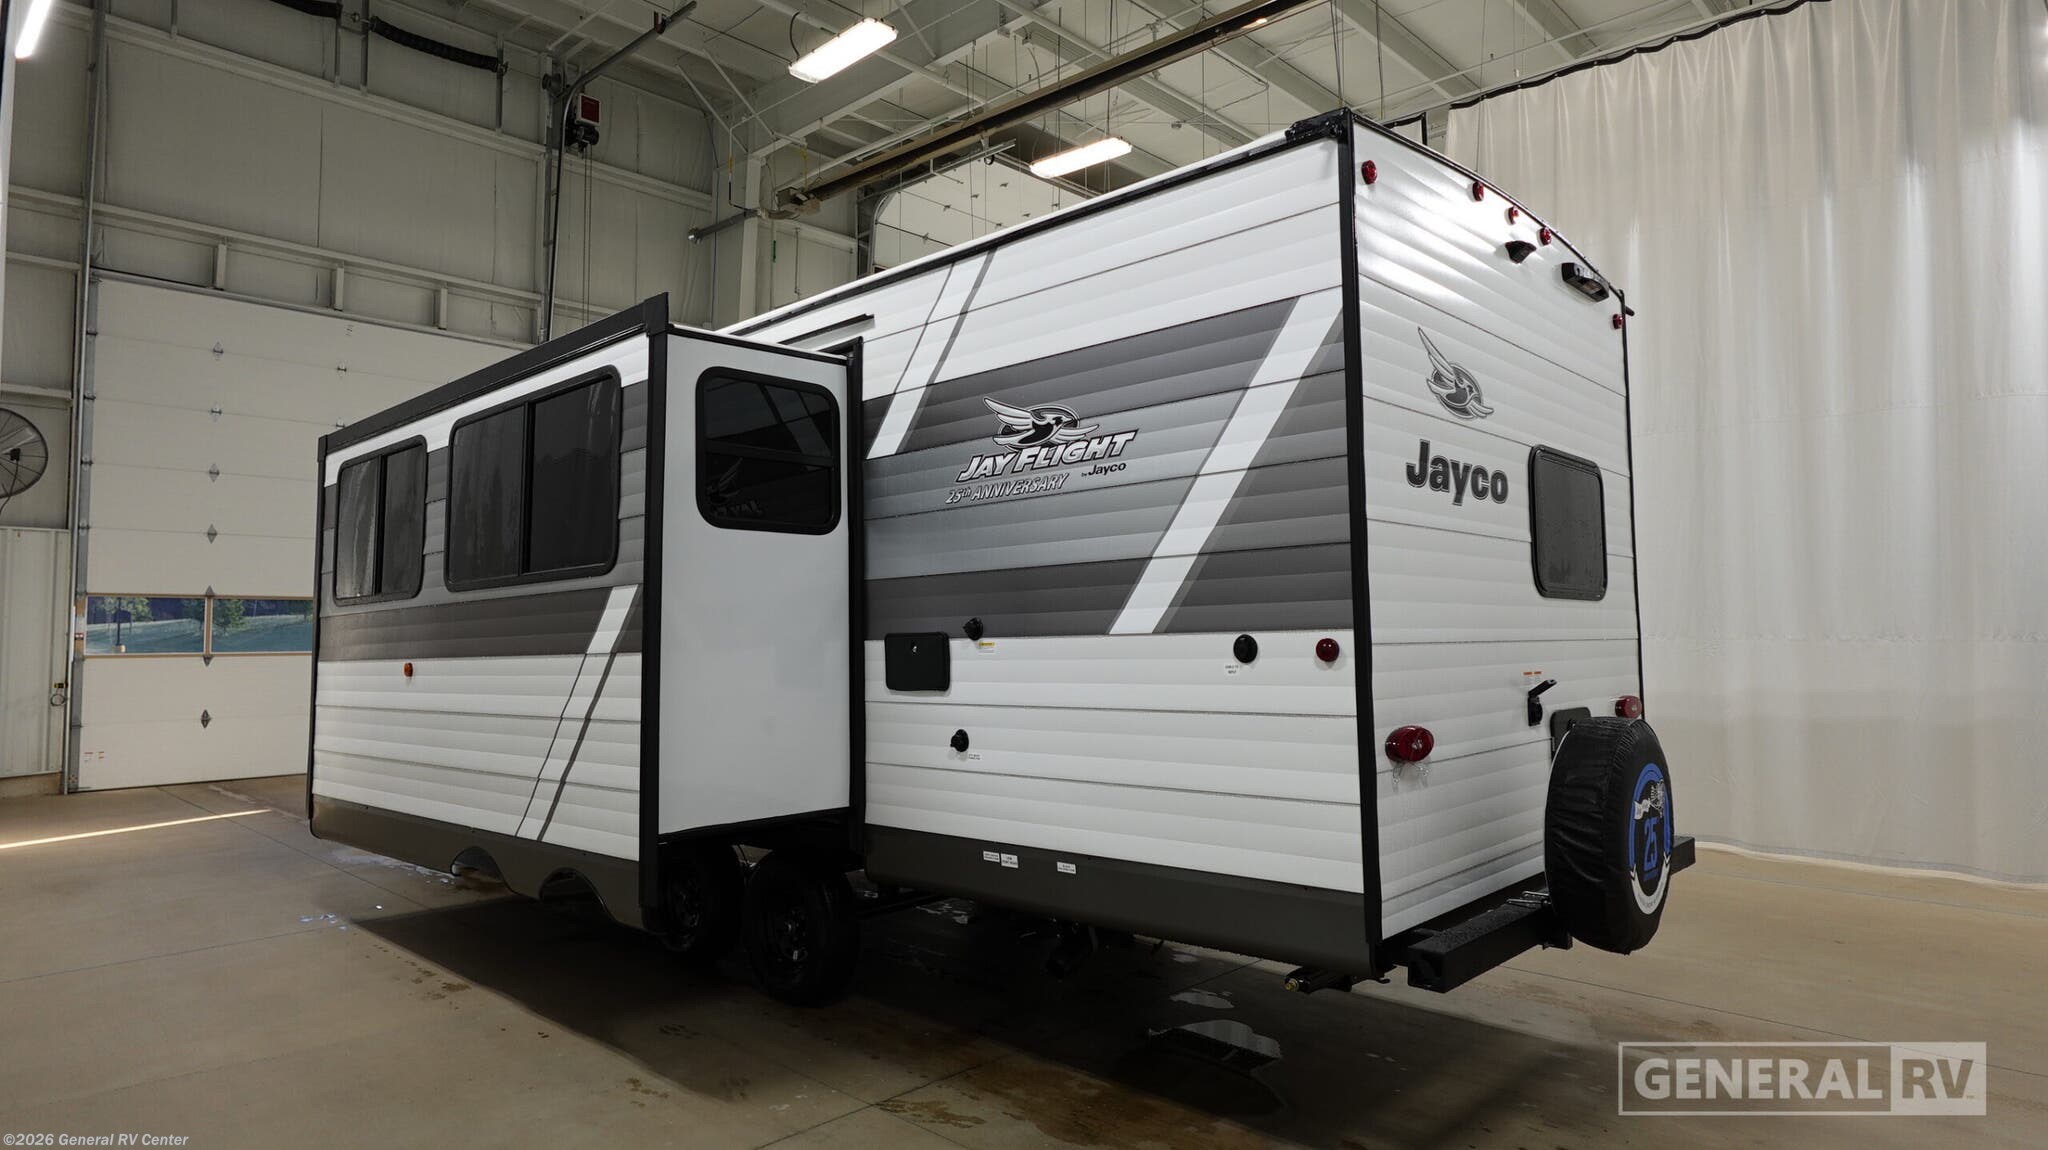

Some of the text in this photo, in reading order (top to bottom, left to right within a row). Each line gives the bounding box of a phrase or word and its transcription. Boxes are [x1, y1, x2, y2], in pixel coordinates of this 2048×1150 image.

[956, 428, 1139, 482] JAY FLIGHT
[1088, 462, 1127, 476] Jayco
[1405, 438, 1509, 507] Jayco
[945, 473, 1069, 504] 25th ANNIVERSARY
[1643, 817, 1659, 872] 25
